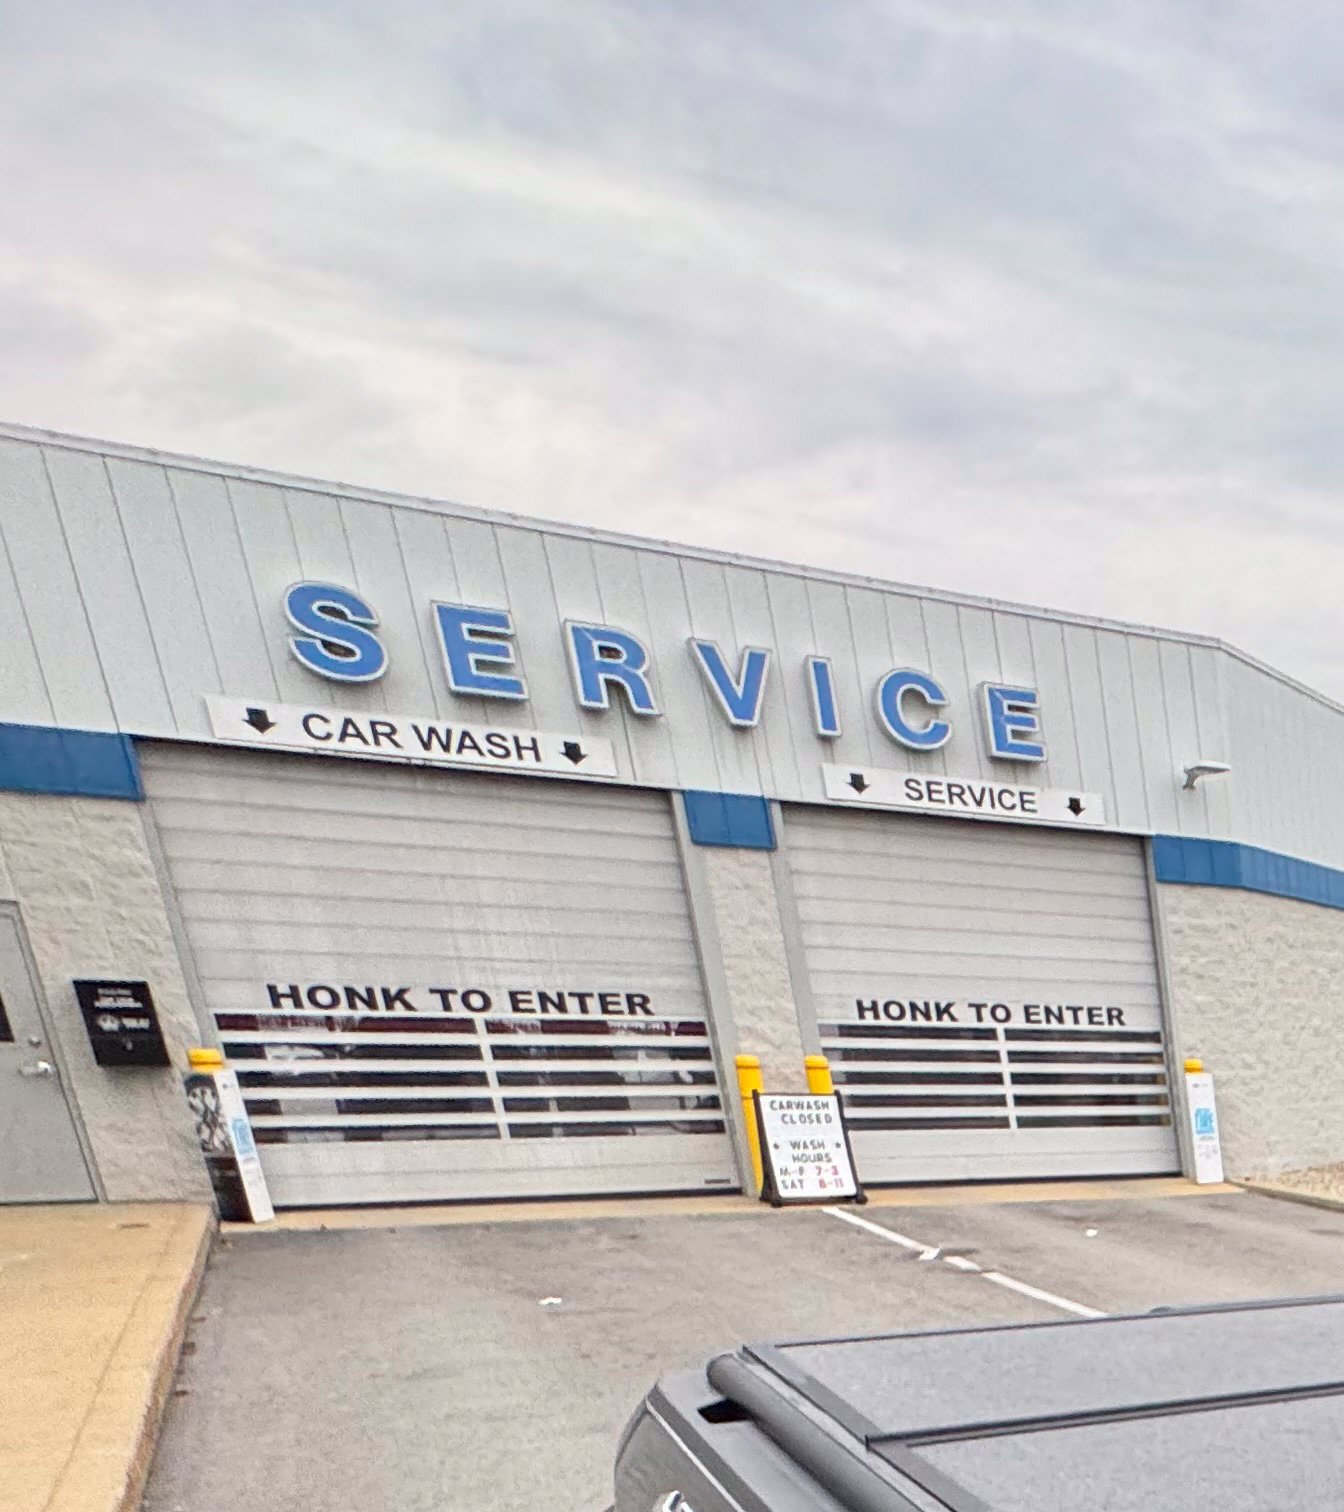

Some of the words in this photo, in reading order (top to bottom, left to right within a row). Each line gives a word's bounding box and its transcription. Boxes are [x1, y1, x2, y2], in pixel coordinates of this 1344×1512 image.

[284, 580, 1048, 763] SERVICE
[301, 712, 404, 751] CAR
[413, 723, 542, 763] WASH
[903, 777, 1039, 814] SERVICE
[266, 984, 415, 1012] HONK
[430, 987, 492, 1014] TO
[508, 990, 655, 1017] ENTER
[856, 998, 959, 1024] HONK
[967, 1001, 1012, 1025] TO
[1023, 1004, 1127, 1028] ENTER
[769, 1100, 830, 1111] CARWASH
[781, 1113, 833, 1125] CLOSED
[790, 1140, 826, 1151] WASH
[792, 1153, 833, 1164] HOURS
